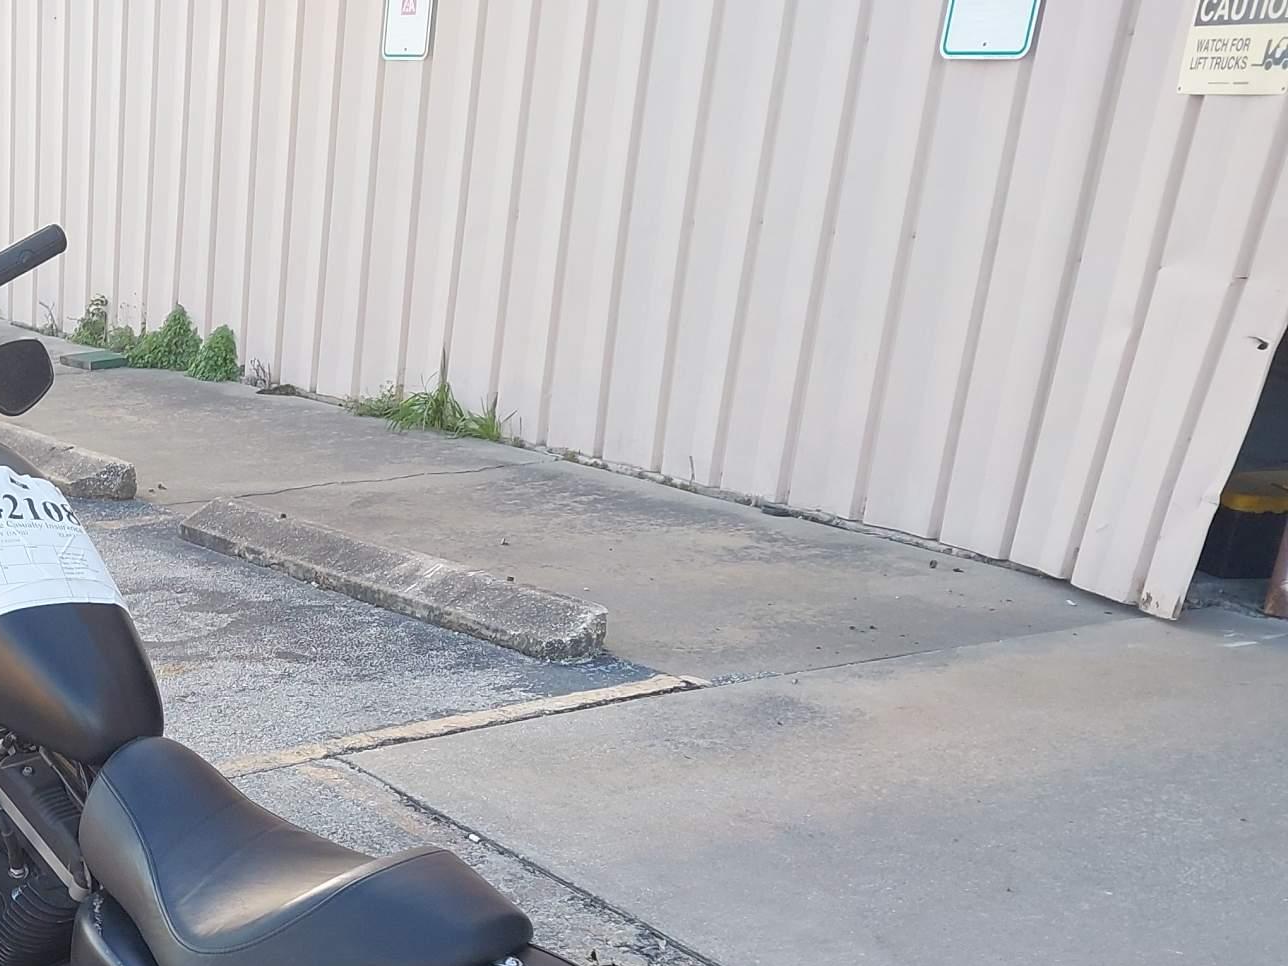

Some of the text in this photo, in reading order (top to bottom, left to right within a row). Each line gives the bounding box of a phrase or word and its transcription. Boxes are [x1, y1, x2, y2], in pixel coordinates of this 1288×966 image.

[1200, 0, 1288, 22] CAUTIO
[1196, 37, 1251, 52] WATCH FOR
[1189, 55, 1249, 70] LIFT TRUCKS
[6, 520, 44, 530] Casualty
